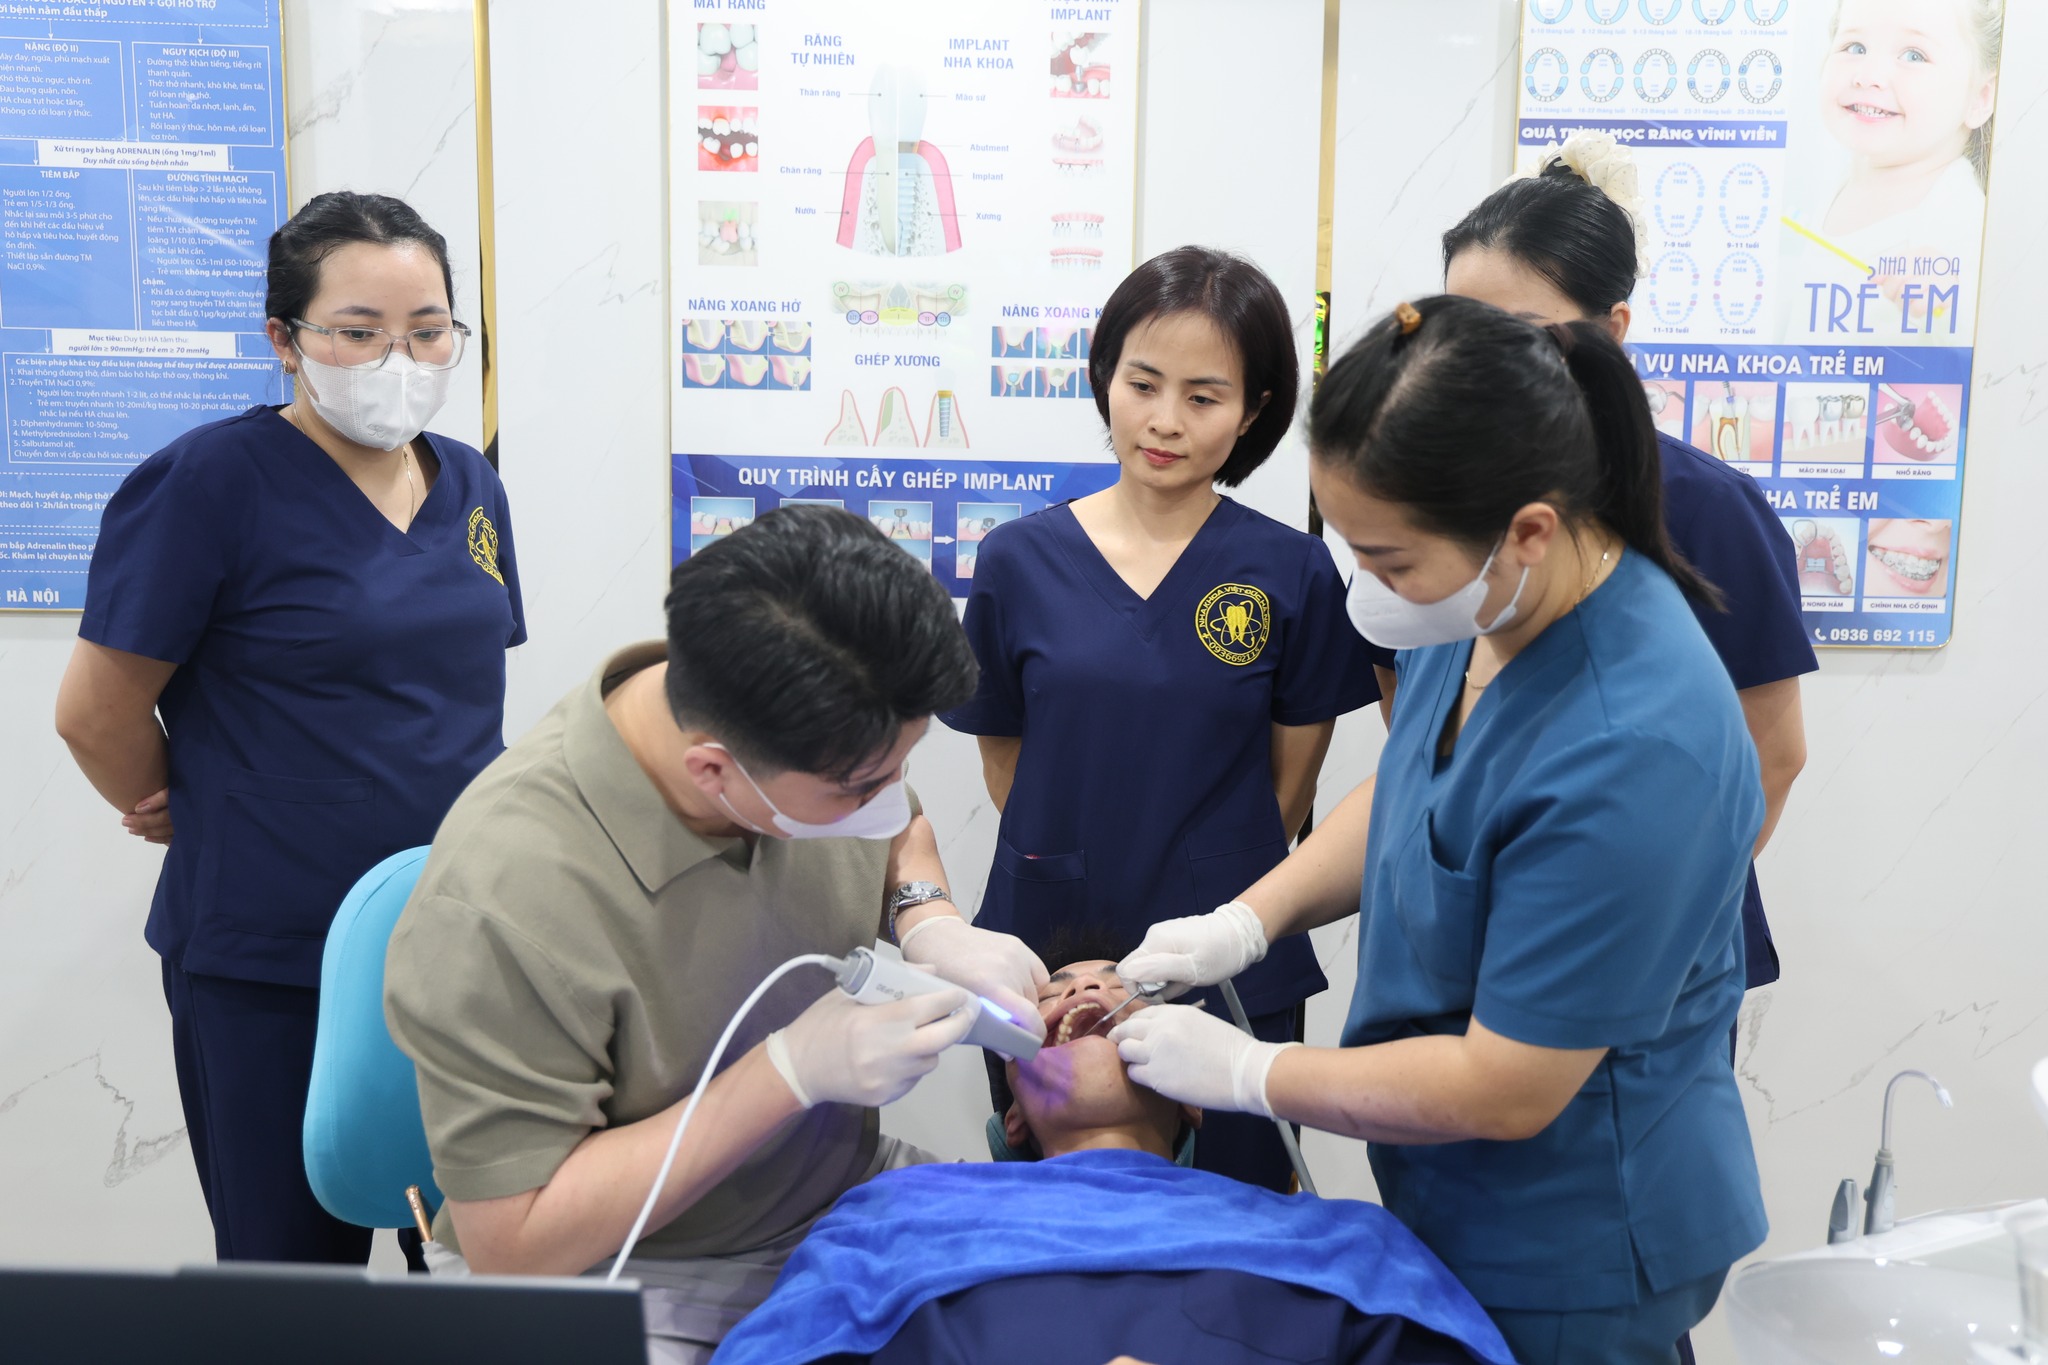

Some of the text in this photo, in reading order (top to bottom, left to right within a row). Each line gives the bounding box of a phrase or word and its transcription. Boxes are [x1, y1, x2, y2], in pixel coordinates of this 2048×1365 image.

[9, 4, 36, 16] bệnh
[38, 4, 61, 16] nằm
[62, 6, 82, 16] đầu
[84, 7, 108, 19] thấp
[1051, 8, 1112, 21] IMPLANT
[24, 42, 79, 53] NẶNG (ĐỘ II)
[804, 34, 842, 47] RĂNG
[949, 38, 1009, 51] IMPLANT
[162, 48, 240, 59] NGUY KỊCH (ĐỘ III)
[791, 52, 855, 67] TỰ NHIÊN
[944, 56, 1014, 69] NHA KHOA
[1521, 125, 1557, 139] QUÁ
[1609, 128, 1646, 143] MỌC
[1648, 126, 1694, 140] RĂNG
[1697, 126, 1737, 141] VĨNH
[1740, 125, 1777, 141] VIỄN
[40, 170, 80, 179] TIÊM BẮP
[167, 173, 248, 184] ĐƯỜNG TĨNH MẠCH
[1878, 256, 1960, 276] NHA KHOA
[688, 297, 802, 313] NÂNG XOANG HỞ
[1804, 265, 1959, 334] TRẺ EM
[1002, 304, 1039, 318] NÂNG
[1045, 306, 1090, 319] XOANG
[855, 354, 941, 367] GHÉP XƯƠNG
[1643, 353, 1675, 378] VỤ
[1681, 354, 1730, 373] NHA
[1737, 355, 1803, 374] KHOA
[1809, 350, 1846, 375] TRẺ
[1853, 356, 1884, 376] EM
[738, 465, 1055, 491] QUY TRÌNH CẤY GHÉP IMPLANT
[1762, 485, 1879, 510] HA TRẺ EM
[6, 587, 60, 605] HÀ NỘI
[1830, 628, 1935, 642] 0936 692 115
